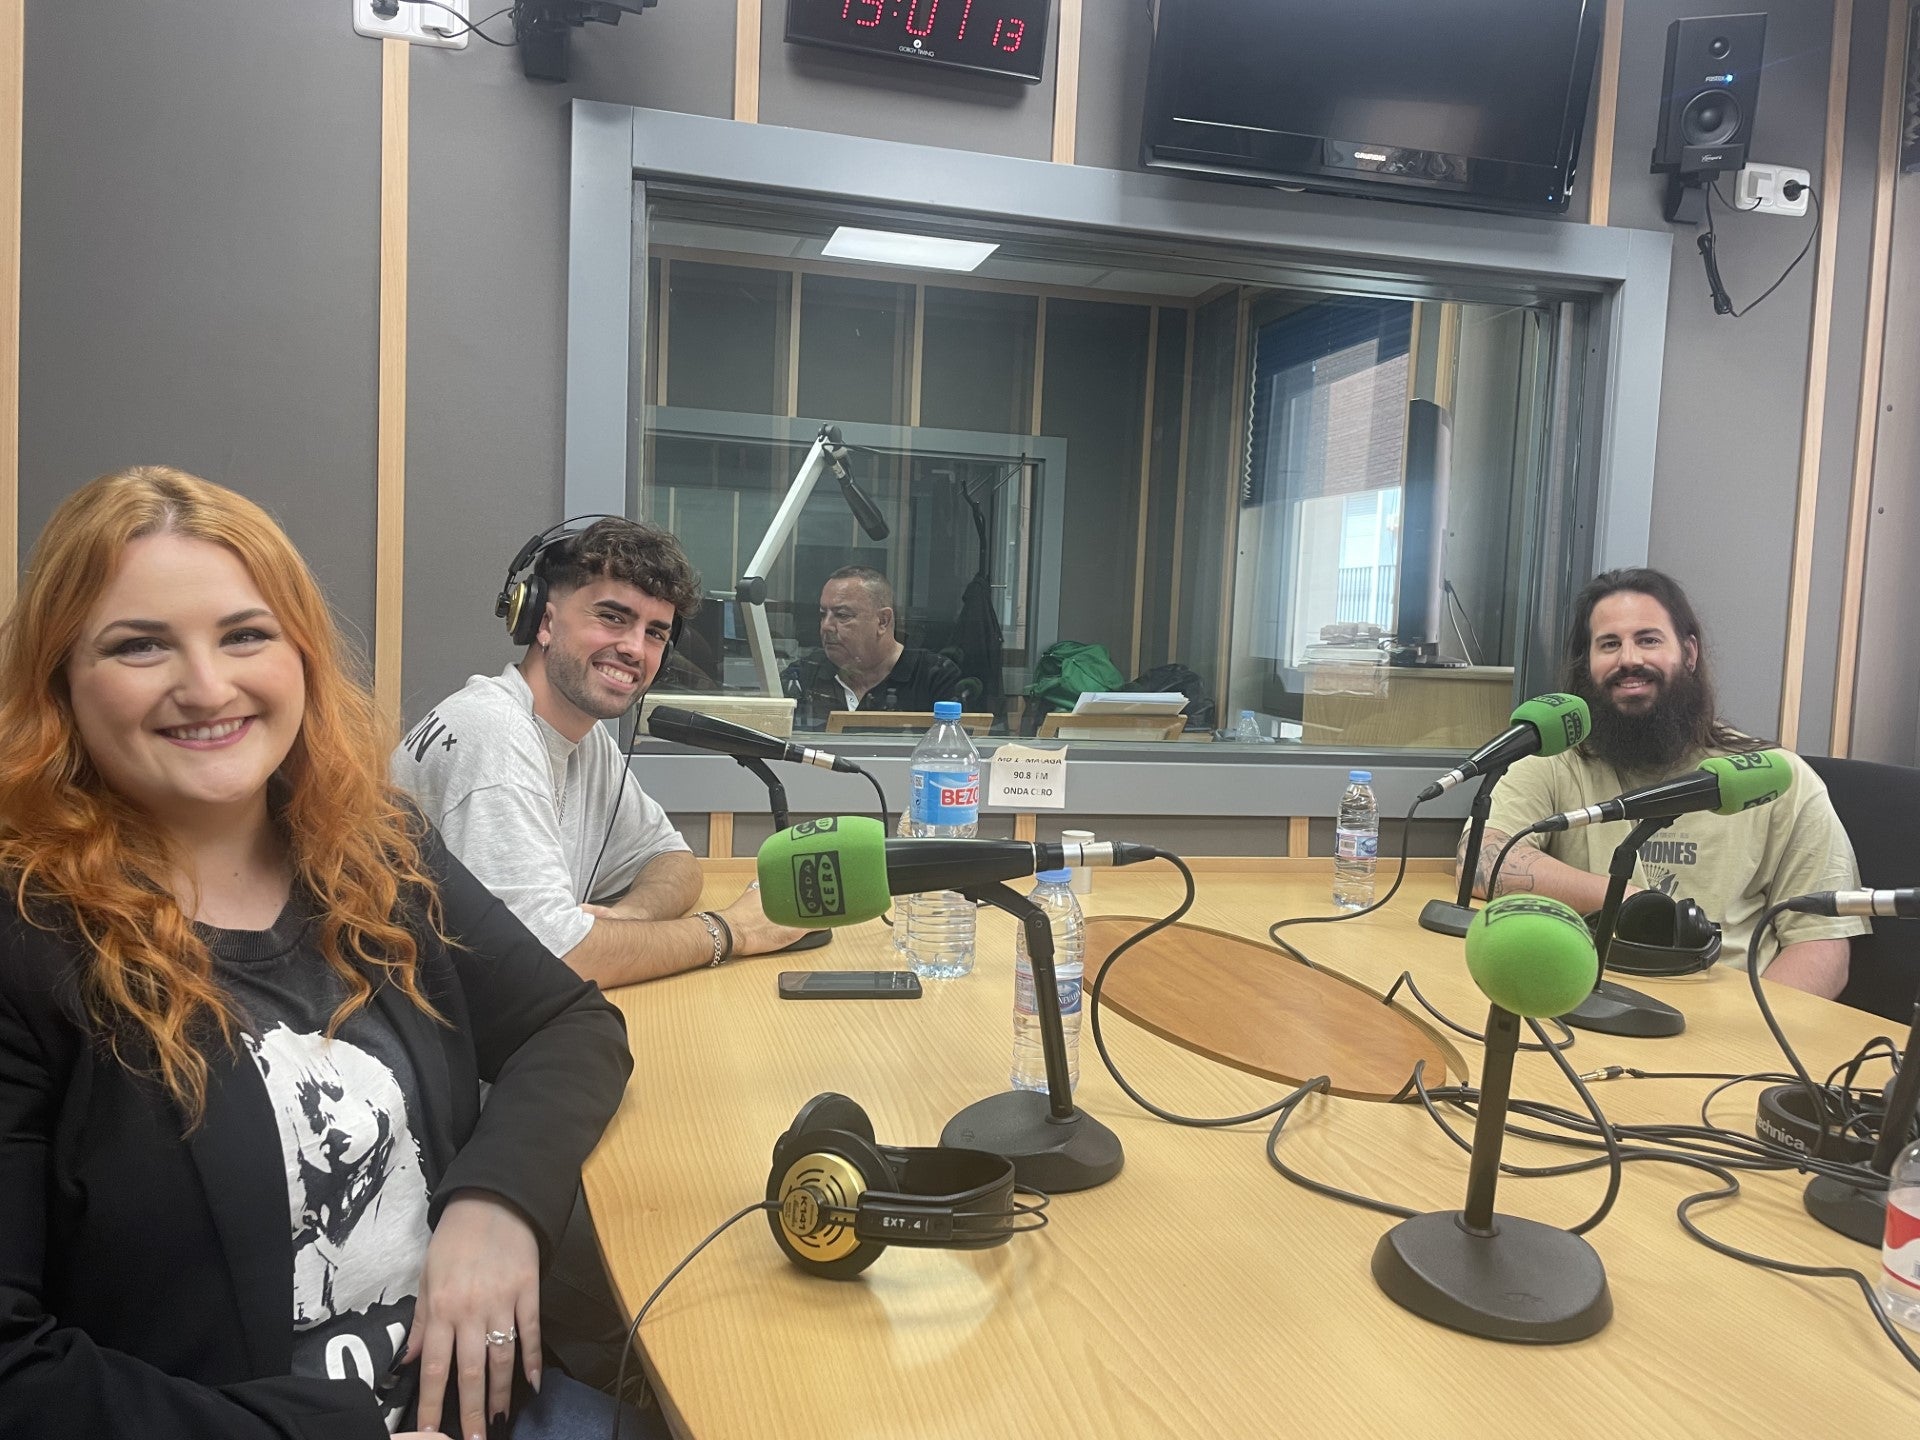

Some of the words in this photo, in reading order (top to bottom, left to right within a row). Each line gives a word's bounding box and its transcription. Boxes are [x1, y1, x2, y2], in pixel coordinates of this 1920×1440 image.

[992, 18, 1025, 52] 13
[1003, 786, 1029, 795] ONDA
[1013, 771, 1031, 780] 90.8
[1035, 772, 1049, 780] FM
[804, 864, 817, 909] ONDA
[821, 862, 836, 906] CERO
